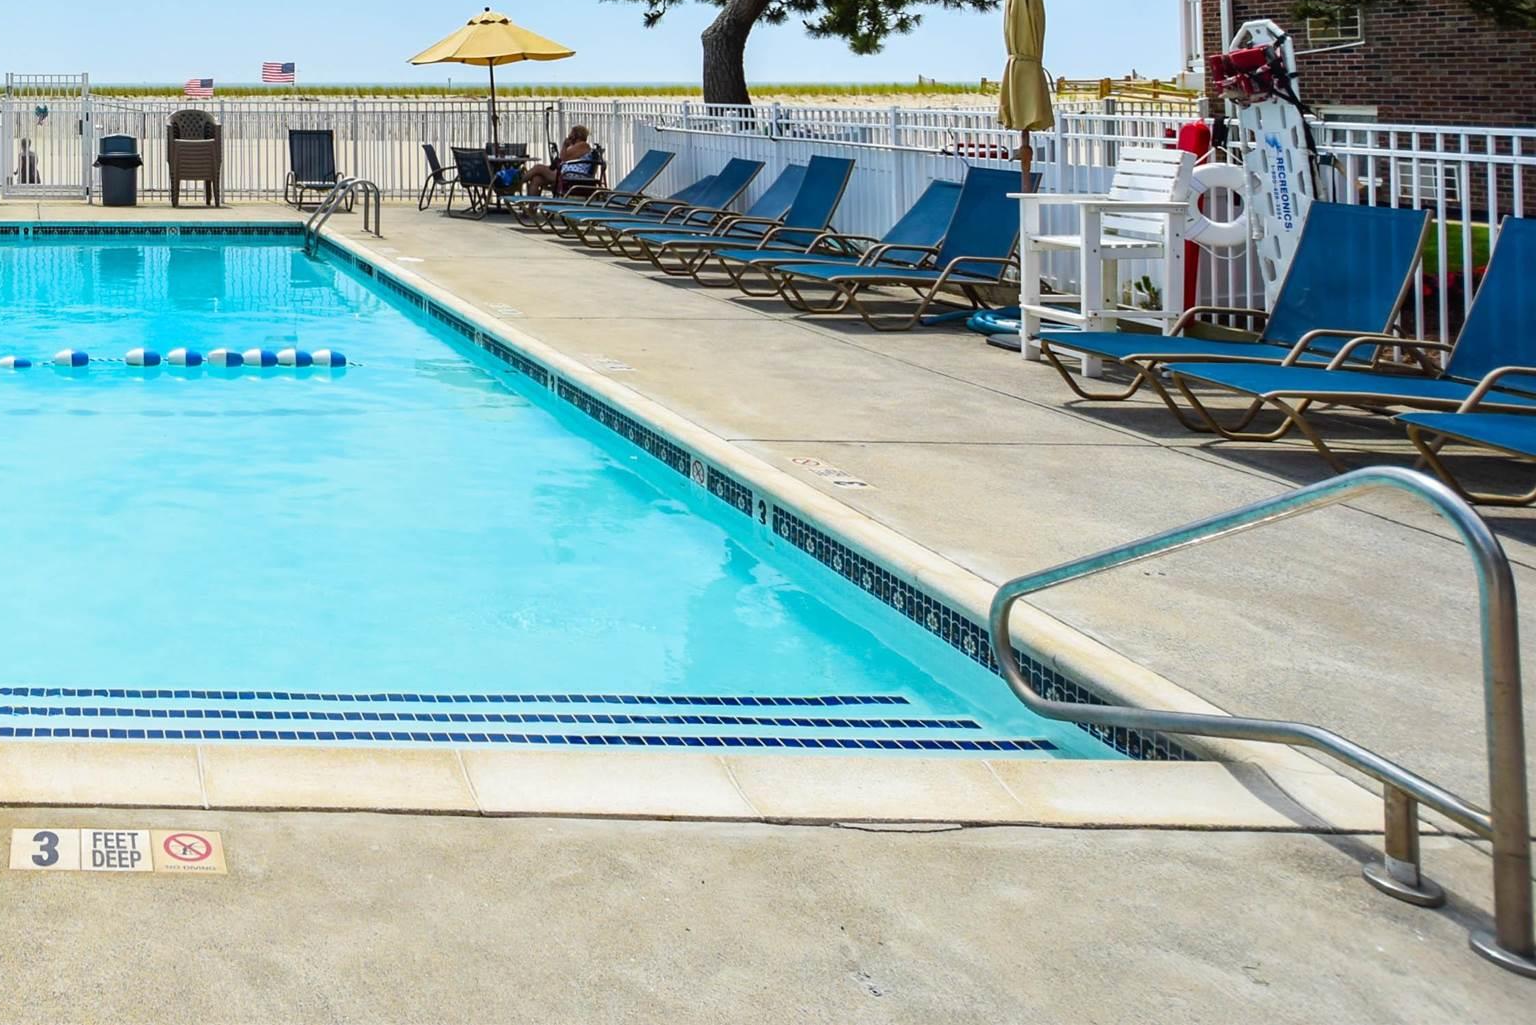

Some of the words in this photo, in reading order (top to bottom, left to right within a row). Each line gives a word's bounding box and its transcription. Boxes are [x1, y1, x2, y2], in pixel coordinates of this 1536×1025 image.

[1275, 157, 1294, 229] RECREONICS
[758, 499, 767, 525] 3
[31, 830, 59, 867] 3
[92, 831, 139, 849] FEET
[91, 850, 142, 869] DEEP
